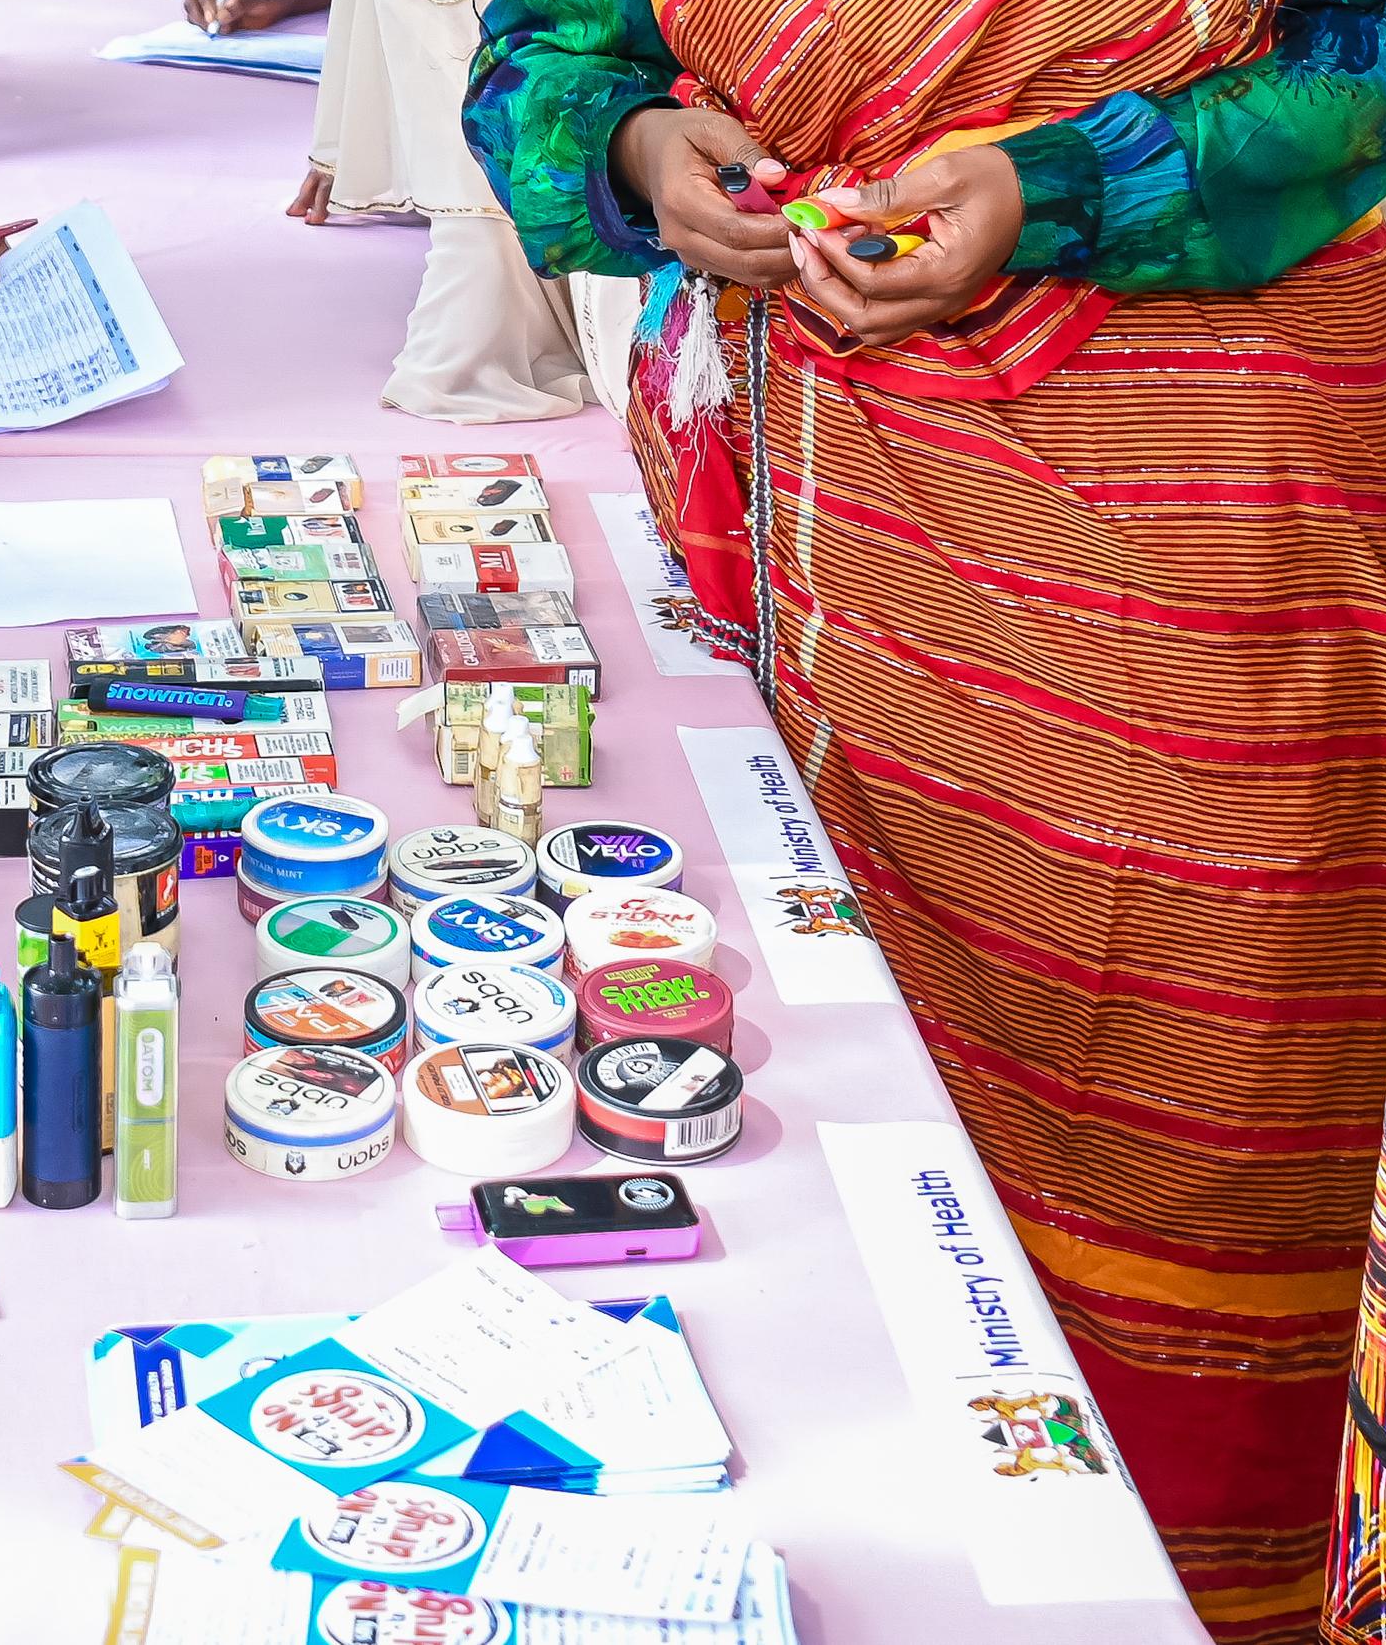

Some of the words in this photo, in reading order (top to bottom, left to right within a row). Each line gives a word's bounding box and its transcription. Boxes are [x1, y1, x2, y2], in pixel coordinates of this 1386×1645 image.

[745, 755, 792, 797] Health
[763, 799, 799, 814] of
[578, 843, 662, 858] VELO
[779, 816, 827, 873] Ministry
[911, 1168, 974, 1242] Health
[939, 1243, 985, 1266] of
[961, 1273, 1030, 1369] Ministry
